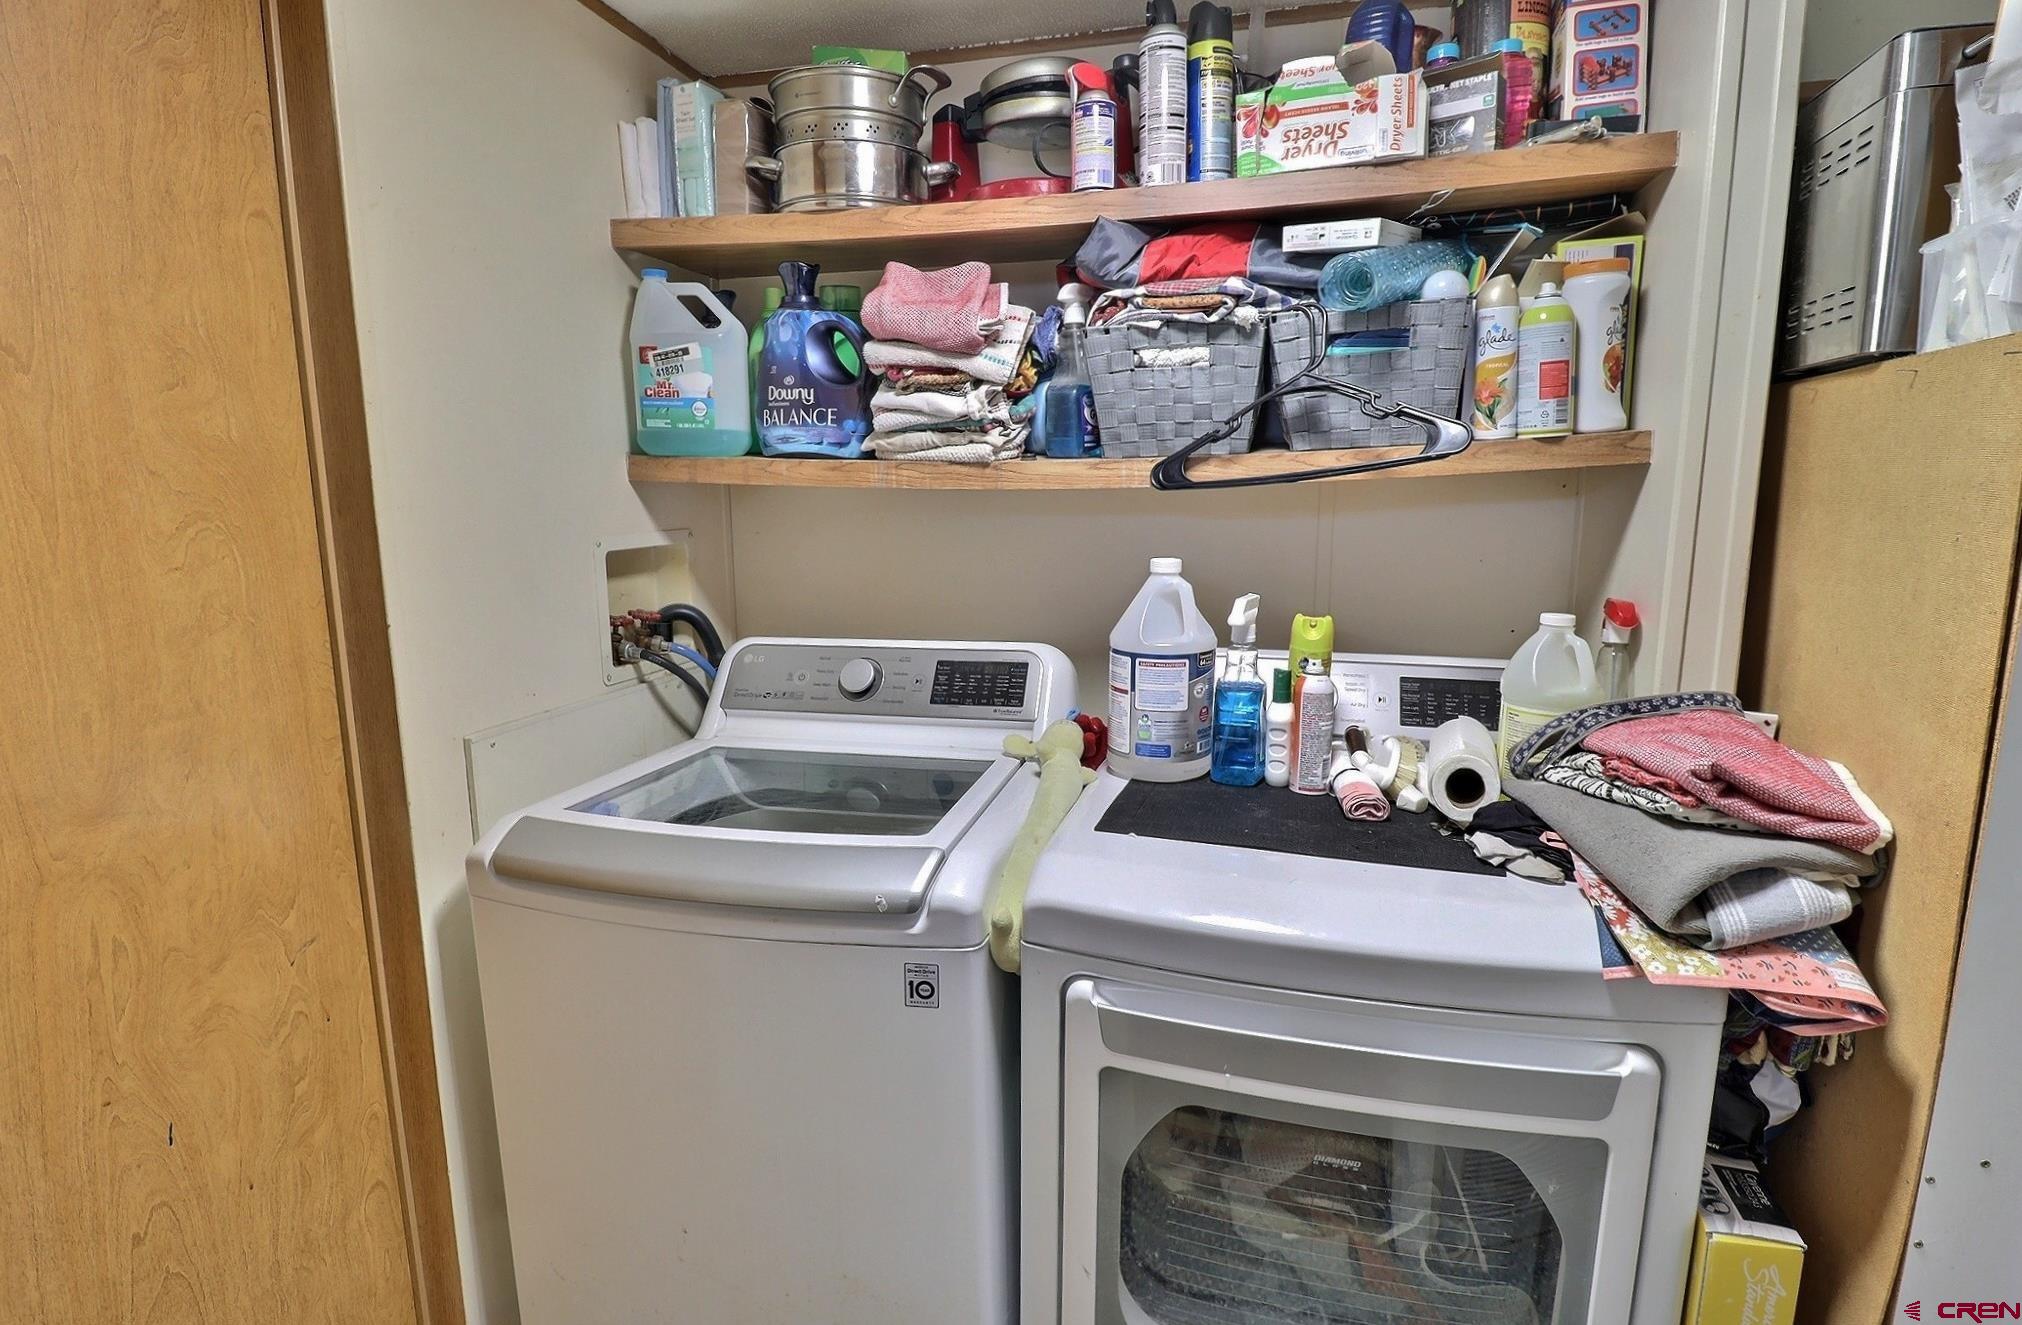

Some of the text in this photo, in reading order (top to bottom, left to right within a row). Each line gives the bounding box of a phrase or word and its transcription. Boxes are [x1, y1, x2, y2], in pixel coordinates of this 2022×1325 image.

[1390, 76, 1405, 151] Dryer Sheets
[1281, 121, 1351, 143] Sheets
[1280, 139, 1339, 161] Dryer
[655, 363, 685, 378] 418291
[644, 386, 681, 399] Clean
[655, 380, 675, 390] Mr.
[767, 385, 816, 405] Downy
[763, 407, 839, 428] BALANCE
[908, 980, 935, 1000] 10
[1313, 1154, 1362, 1168] DIAMOND
